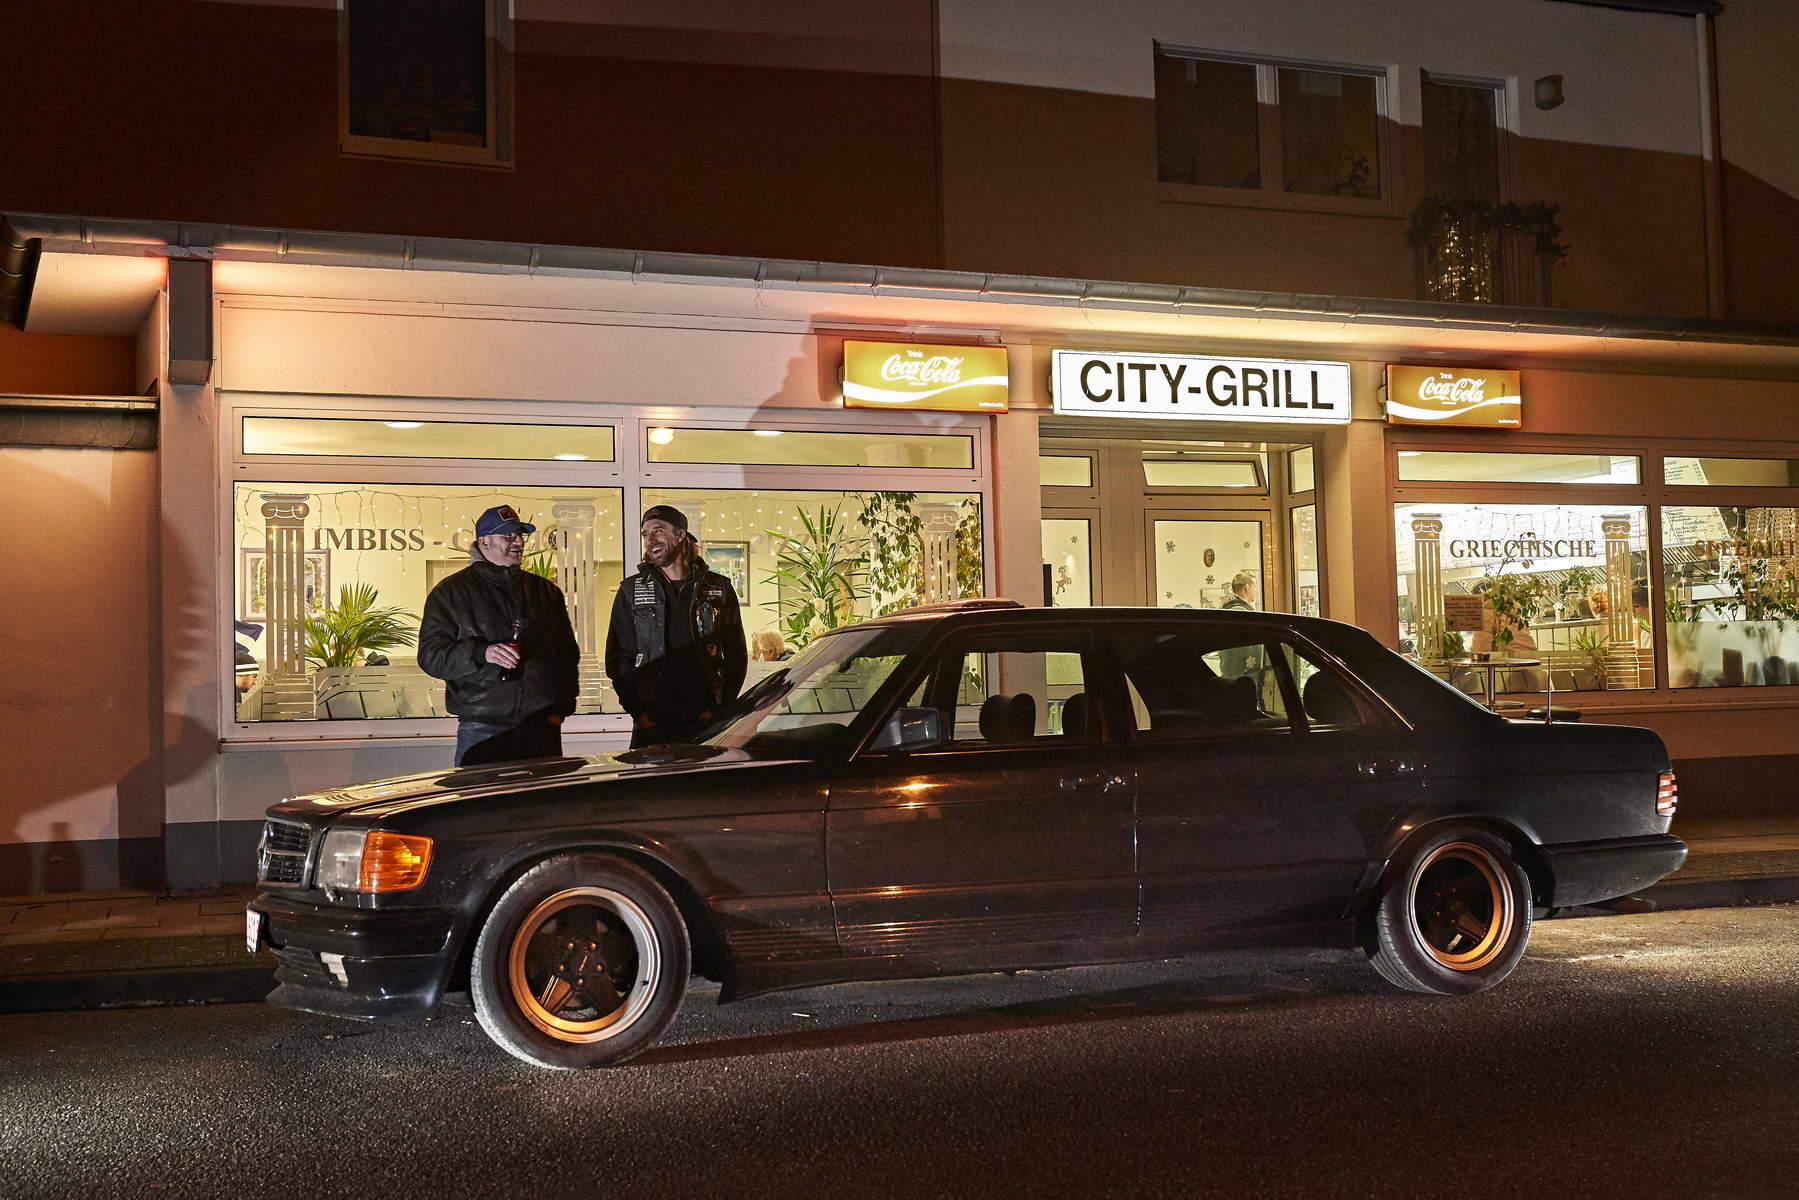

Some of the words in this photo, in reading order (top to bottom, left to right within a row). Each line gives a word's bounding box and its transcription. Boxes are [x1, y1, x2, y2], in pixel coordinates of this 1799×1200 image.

[881, 354, 964, 383] Coca-Cola
[1080, 360, 1334, 409] CITY-GRILL
[1418, 376, 1487, 402] Coca-Cola
[314, 528, 425, 551] IMBISS
[1449, 539, 1597, 558] GRIECHISCHE
